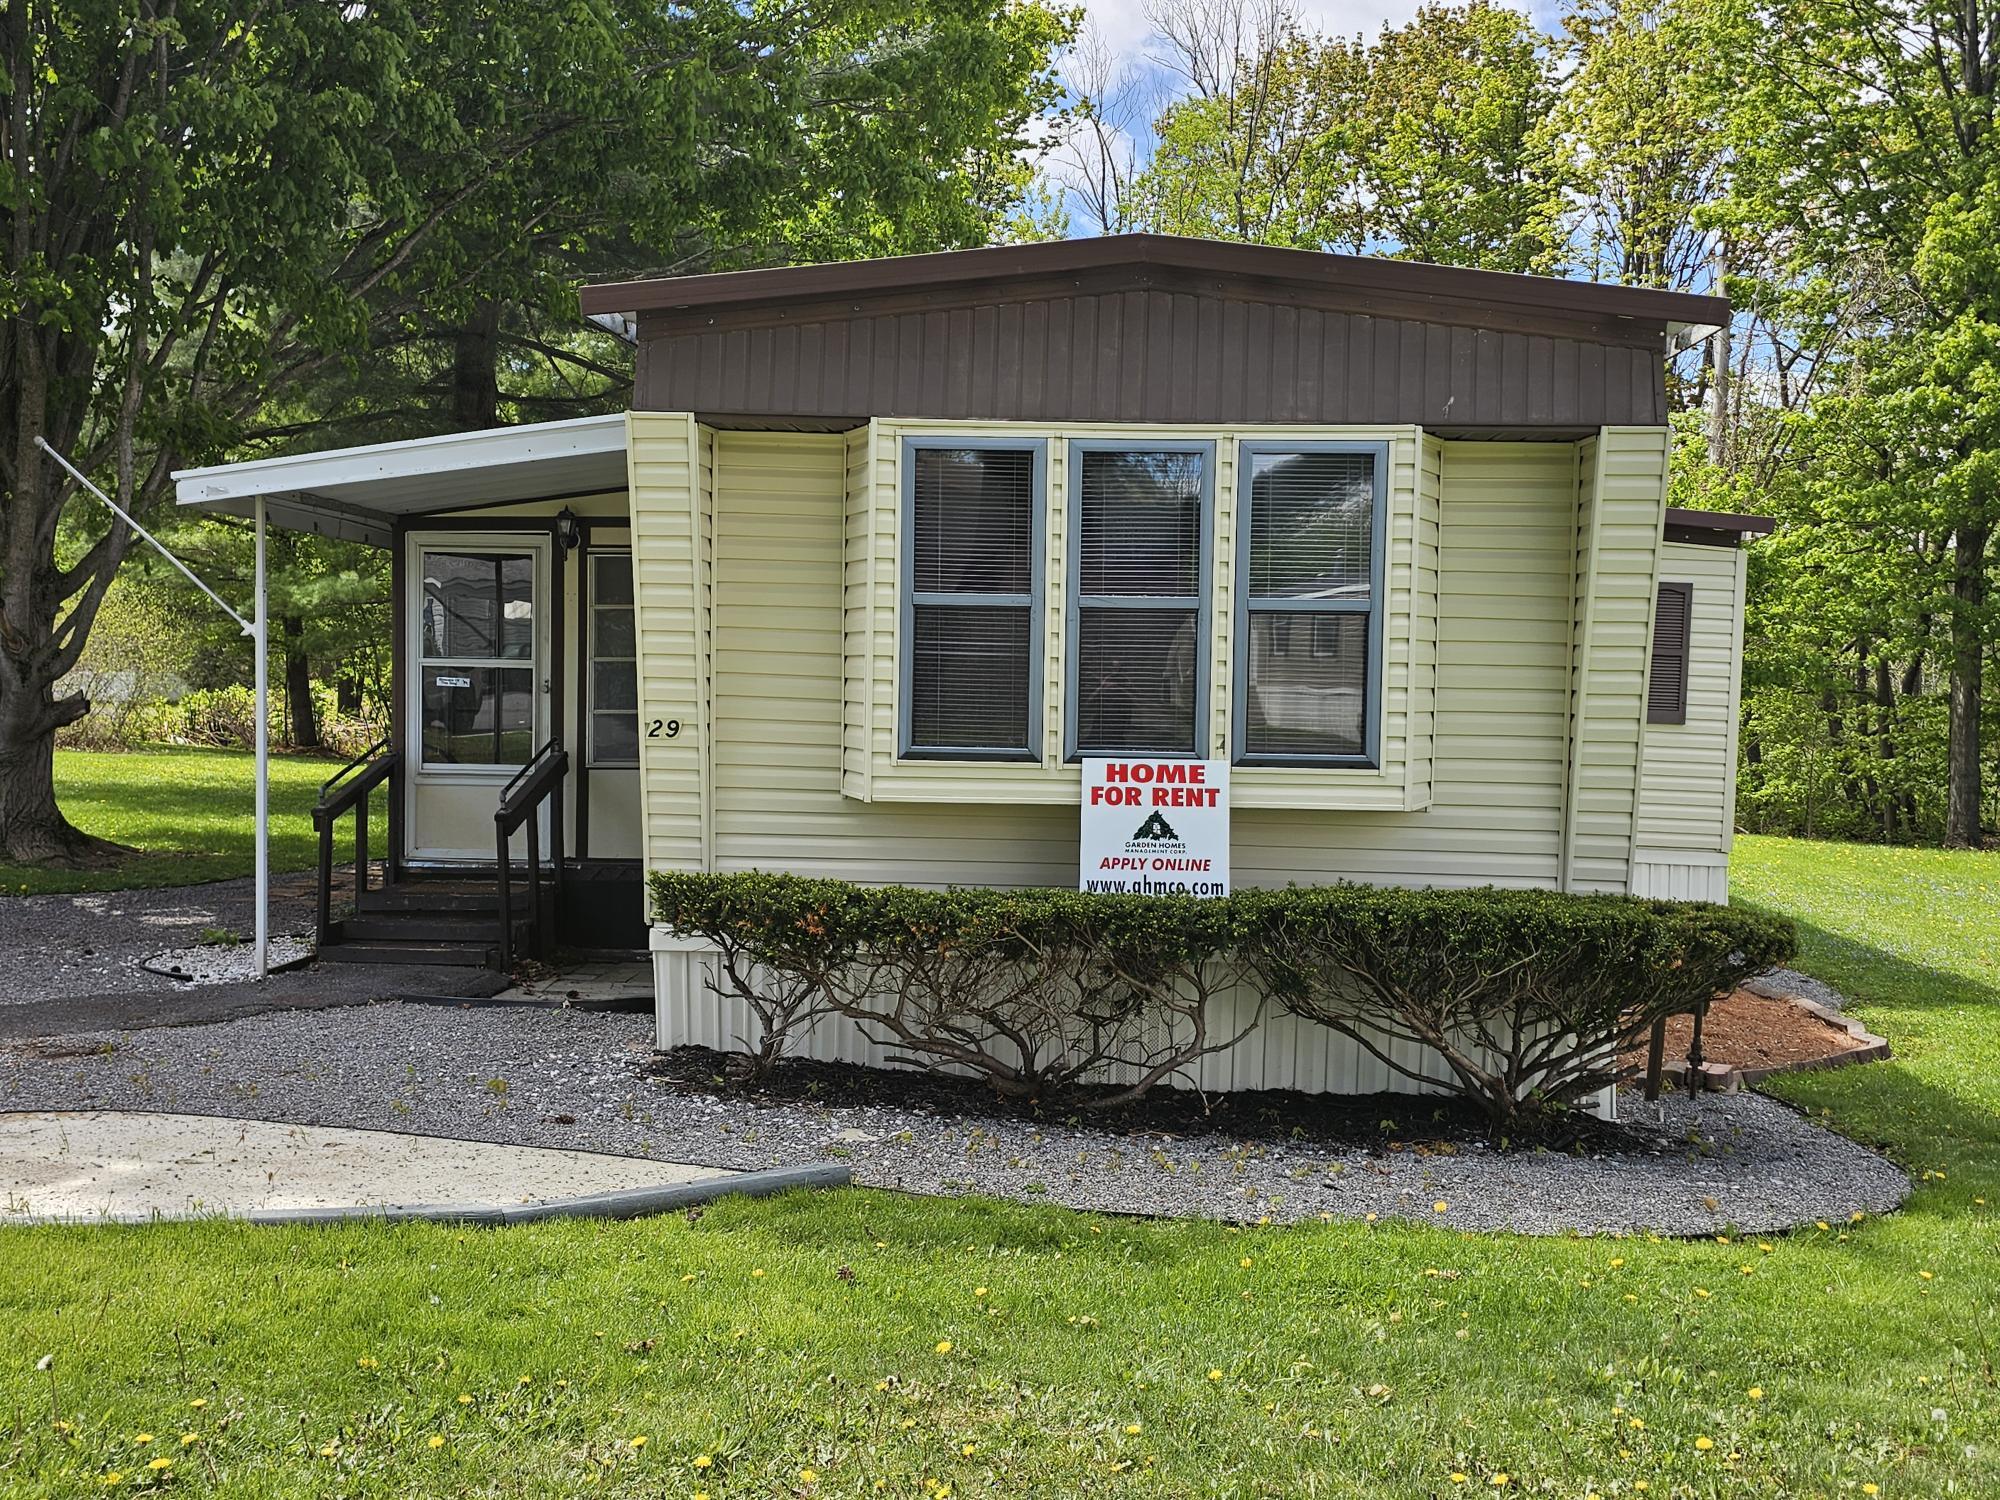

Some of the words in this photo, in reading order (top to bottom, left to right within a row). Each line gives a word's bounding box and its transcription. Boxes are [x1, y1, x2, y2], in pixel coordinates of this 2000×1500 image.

[648, 719, 680, 738] 29
[1106, 763, 1205, 784] HOME
[1091, 786, 1142, 806] FOR
[1152, 787, 1220, 807] RENT
[1100, 857, 1148, 870] APPLY
[1152, 858, 1211, 872] ONLINE
